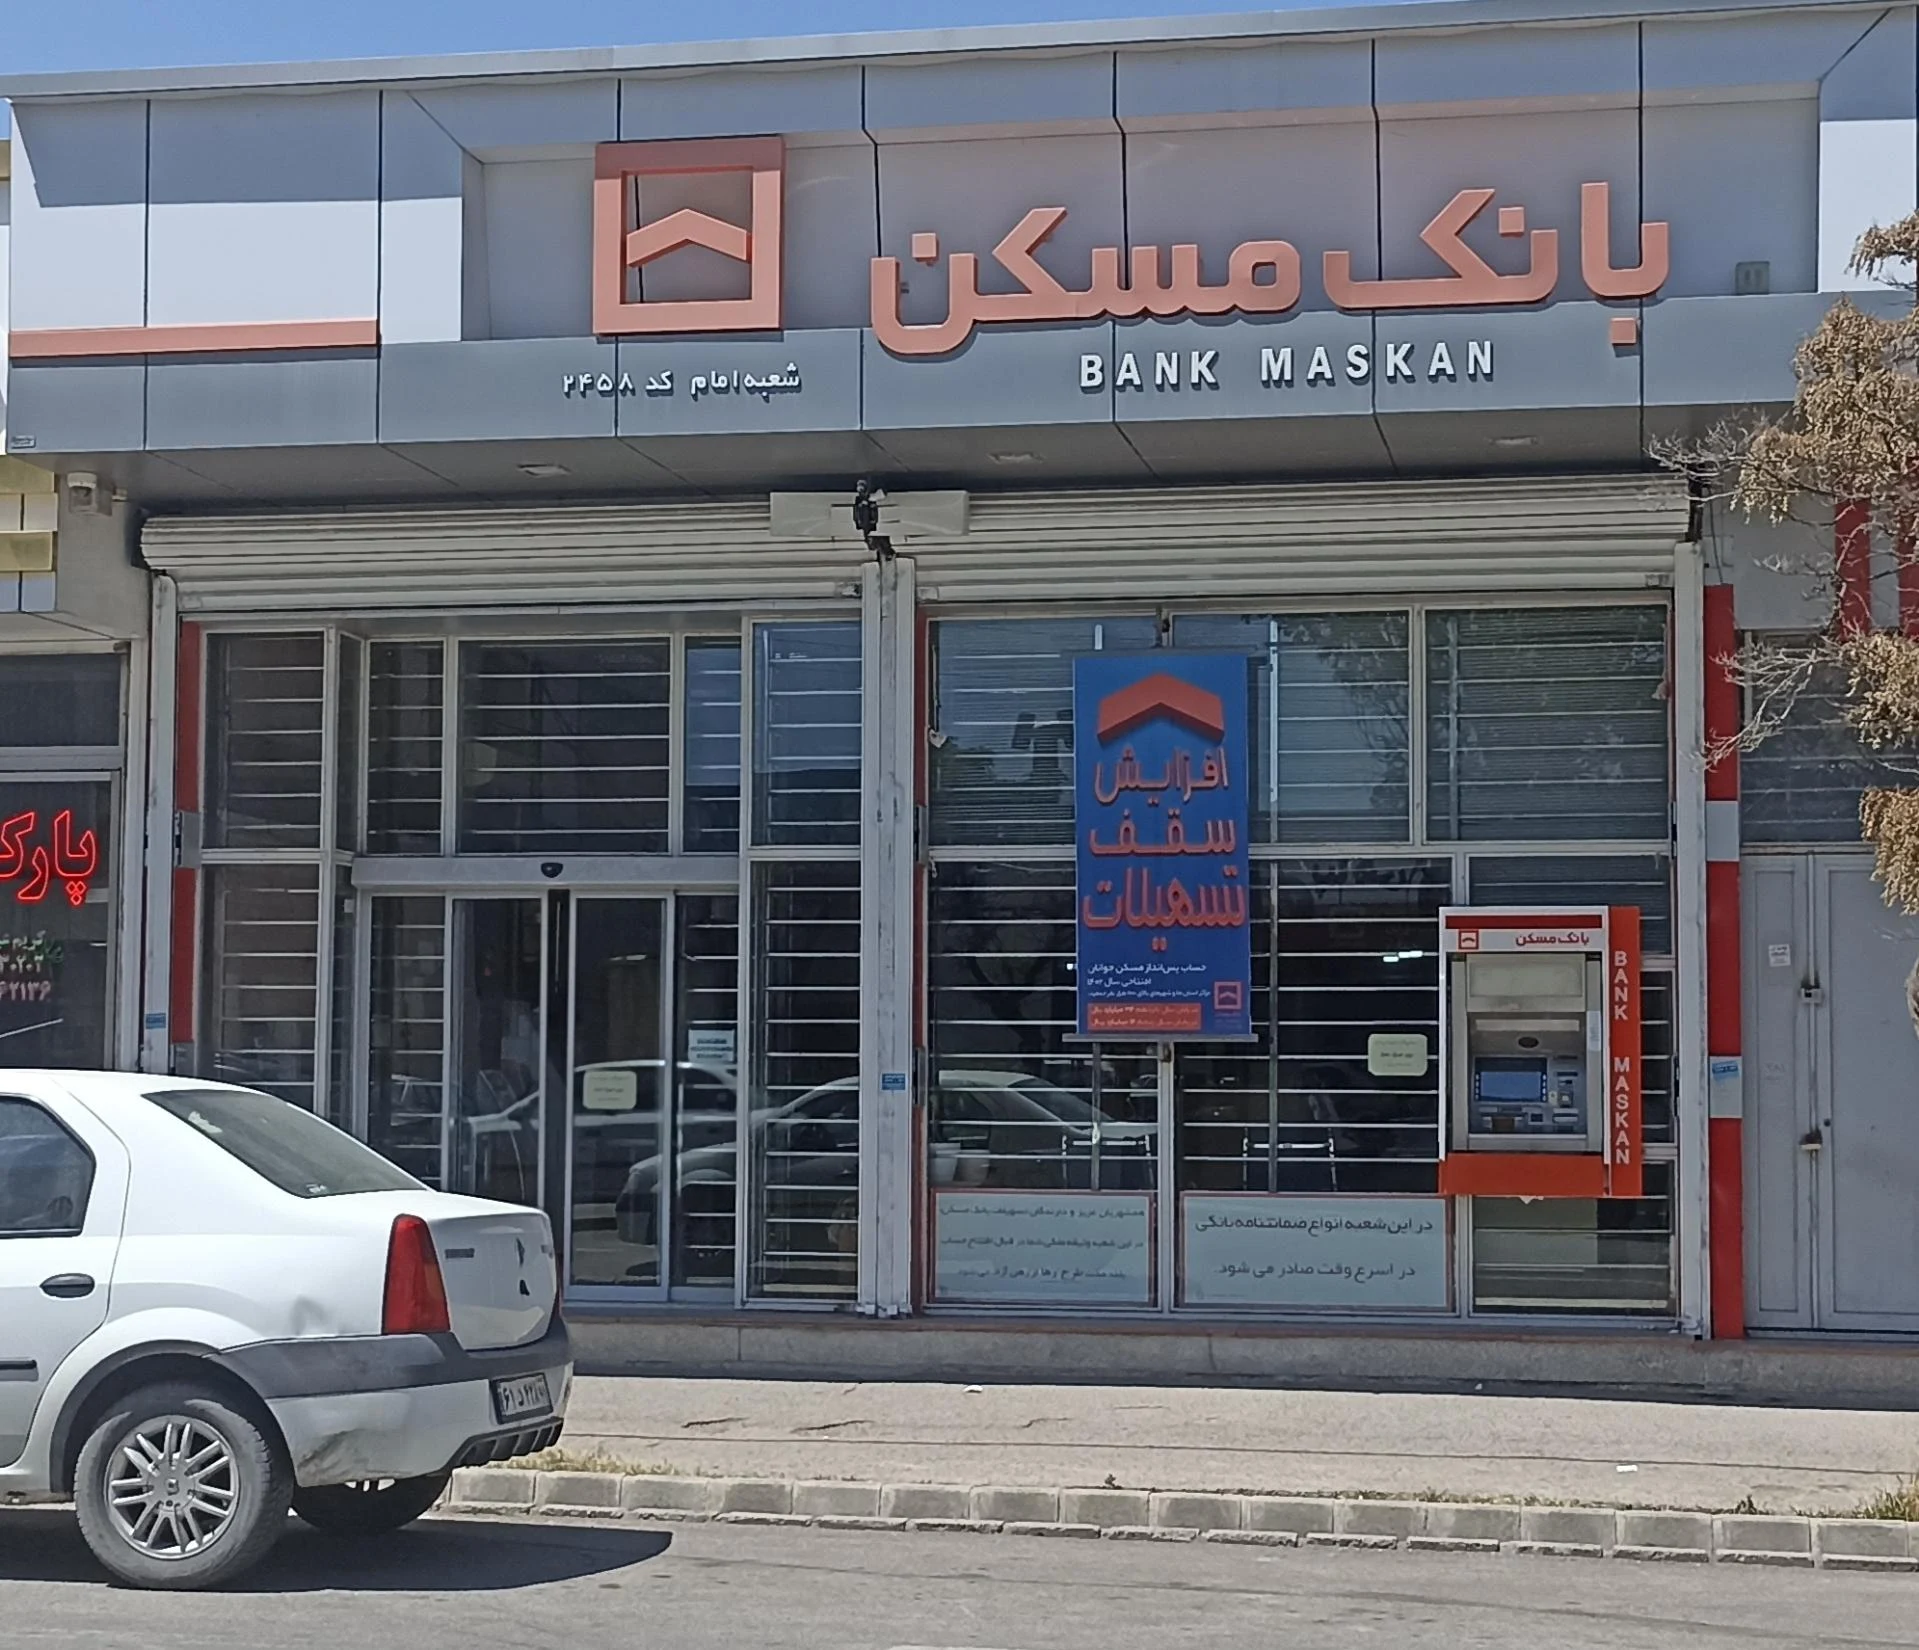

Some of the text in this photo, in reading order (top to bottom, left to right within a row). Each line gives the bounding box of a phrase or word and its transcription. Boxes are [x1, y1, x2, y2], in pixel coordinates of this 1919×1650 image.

[871, 182, 1669, 354] بانک مسکن
[1080, 340, 1494, 390] BANK MASKAN
[562, 362, 801, 398] شعبه امام کد ۲۴۵۸
[1095, 743, 1229, 806] افزایش
[1089, 808, 1236, 856] سقف
[1083, 864, 1246, 952] تسهیلات
[1515, 932, 1590, 947] بانک مسکن
[1087, 963, 1115, 974] جوانان
[1115, 963, 1144, 974] مسکن
[1180, 963, 1207, 974] حساب
[1104, 976, 1121, 988] سال
[1614, 950, 1629, 1020] BANK
[1614, 1056, 1630, 1165] MASKAN
[1195, 1214, 1234, 1232] بانکی
[1308, 1216, 1342, 1237] انواع
[1344, 1217, 1387, 1232] شعبه
[1387, 1217, 1412, 1234] این
[1415, 1220, 1433, 1234] در
[1252, 1265, 1275, 1279] می
[1278, 1262, 1315, 1279] صادر
[1316, 1262, 1352, 1279] وقت
[1353, 1262, 1394, 1284] اسرع
[1398, 1266, 1416, 1280] در
